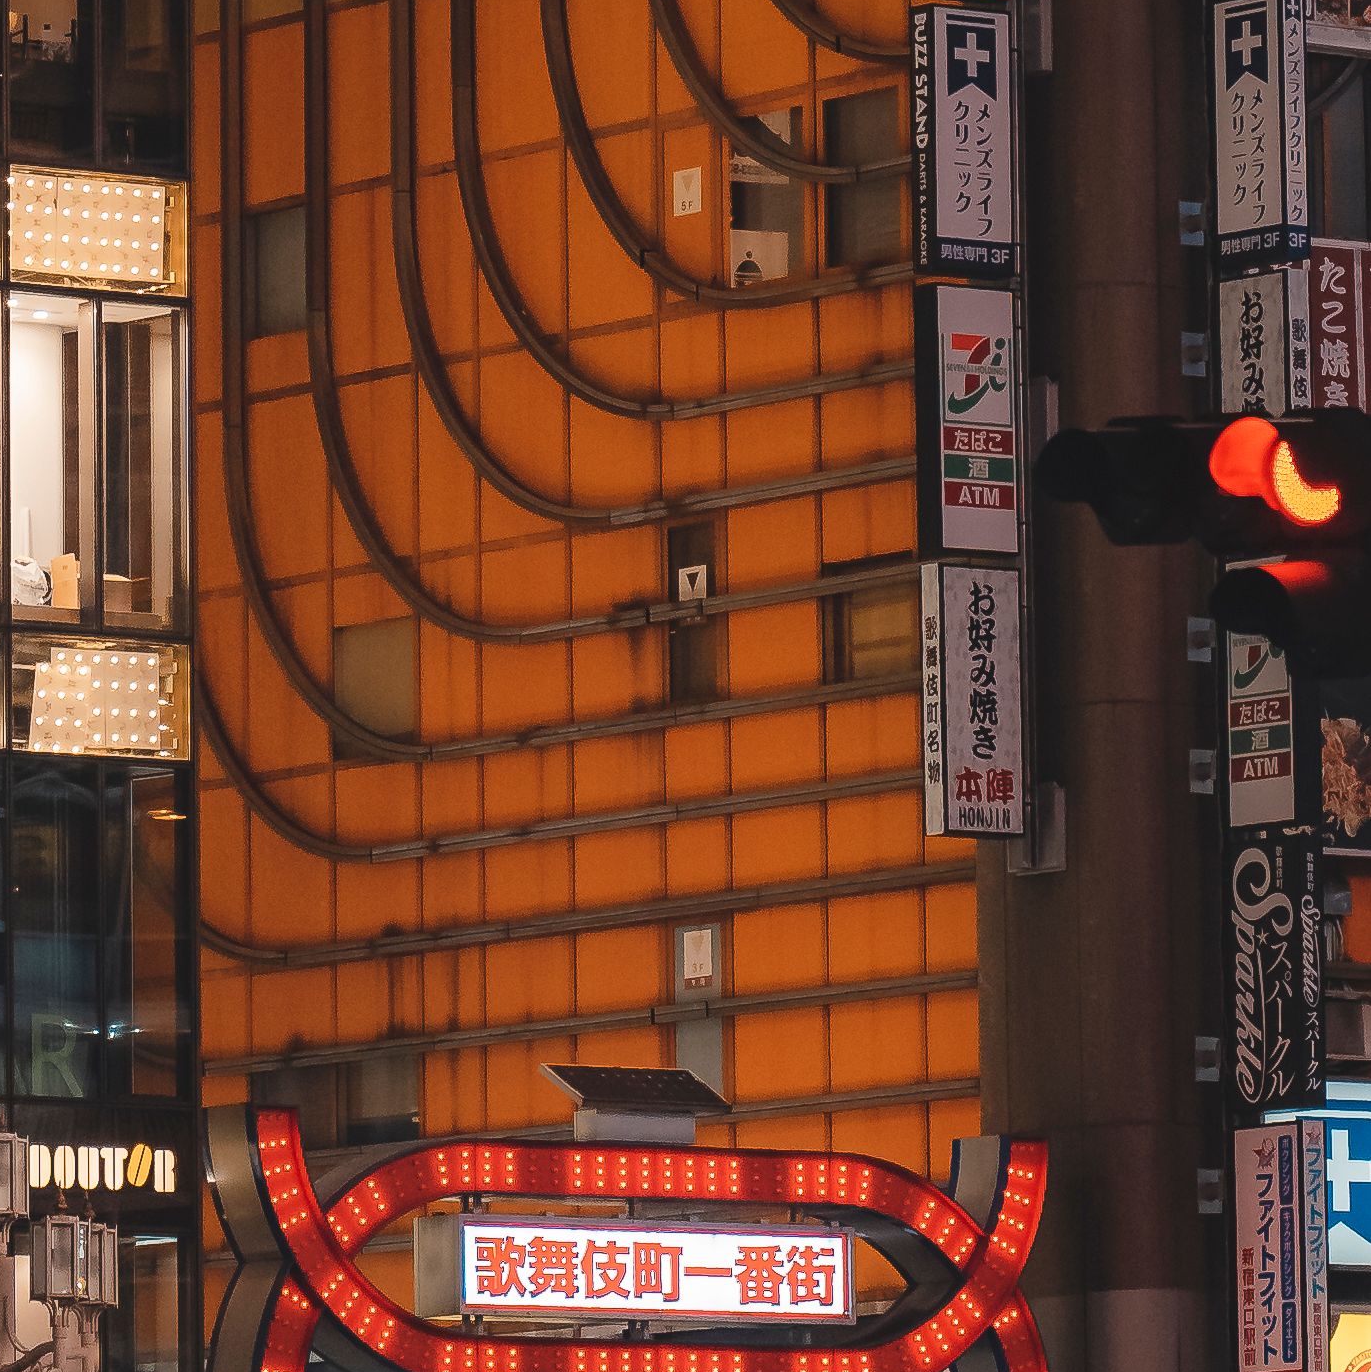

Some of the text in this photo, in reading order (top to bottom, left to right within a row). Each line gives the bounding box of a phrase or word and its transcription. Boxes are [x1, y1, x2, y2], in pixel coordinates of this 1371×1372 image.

[914, 12, 929, 150] BUZZ STAND
[954, 100, 973, 214] クリニック
[1231, 91, 1248, 207] クリニック
[1249, 88, 1267, 225] メンズライフ
[1286, 24, 1304, 223] メンズライフクリニック
[918, 153, 927, 191] DARTS
[975, 101, 994, 238] メンズライフ
[919, 208, 928, 266] KARAOKE
[940, 243, 1010, 264] 男性専門 3F
[1264, 232, 1280, 248] 3F
[1288, 233, 1307, 248] 3F
[1291, 318, 1308, 409] 歌舞伎
[954, 429, 1003, 452] たばこ
[968, 457, 989, 479] 酒
[958, 485, 1000, 508] ATM
[924, 615, 941, 785] 歌舞伎町名物
[967, 581, 998, 761] お好み焼き
[1239, 701, 1281, 725] たばこ
[1251, 730, 1269, 751] 酒
[955, 767, 1014, 805] 本陣
[1243, 755, 1279, 779] ATM
[958, 805, 1011, 831] HONJIN
[1231, 847, 1295, 1104] Sparkle
[1301, 894, 1322, 1008] Sparkle
[1266, 941, 1296, 1102] スパークル
[1304, 1011, 1322, 1093] スパークル
[29, 1142, 177, 1194] DOUTOR
[1304, 1147, 1325, 1300] ファイトフィット
[474, 1236, 835, 1306] 歌舞伎町一番街
[1241, 1247, 1256, 1367] 新宿東口駅前
[1254, 1173, 1279, 1366] ファイトフィット
